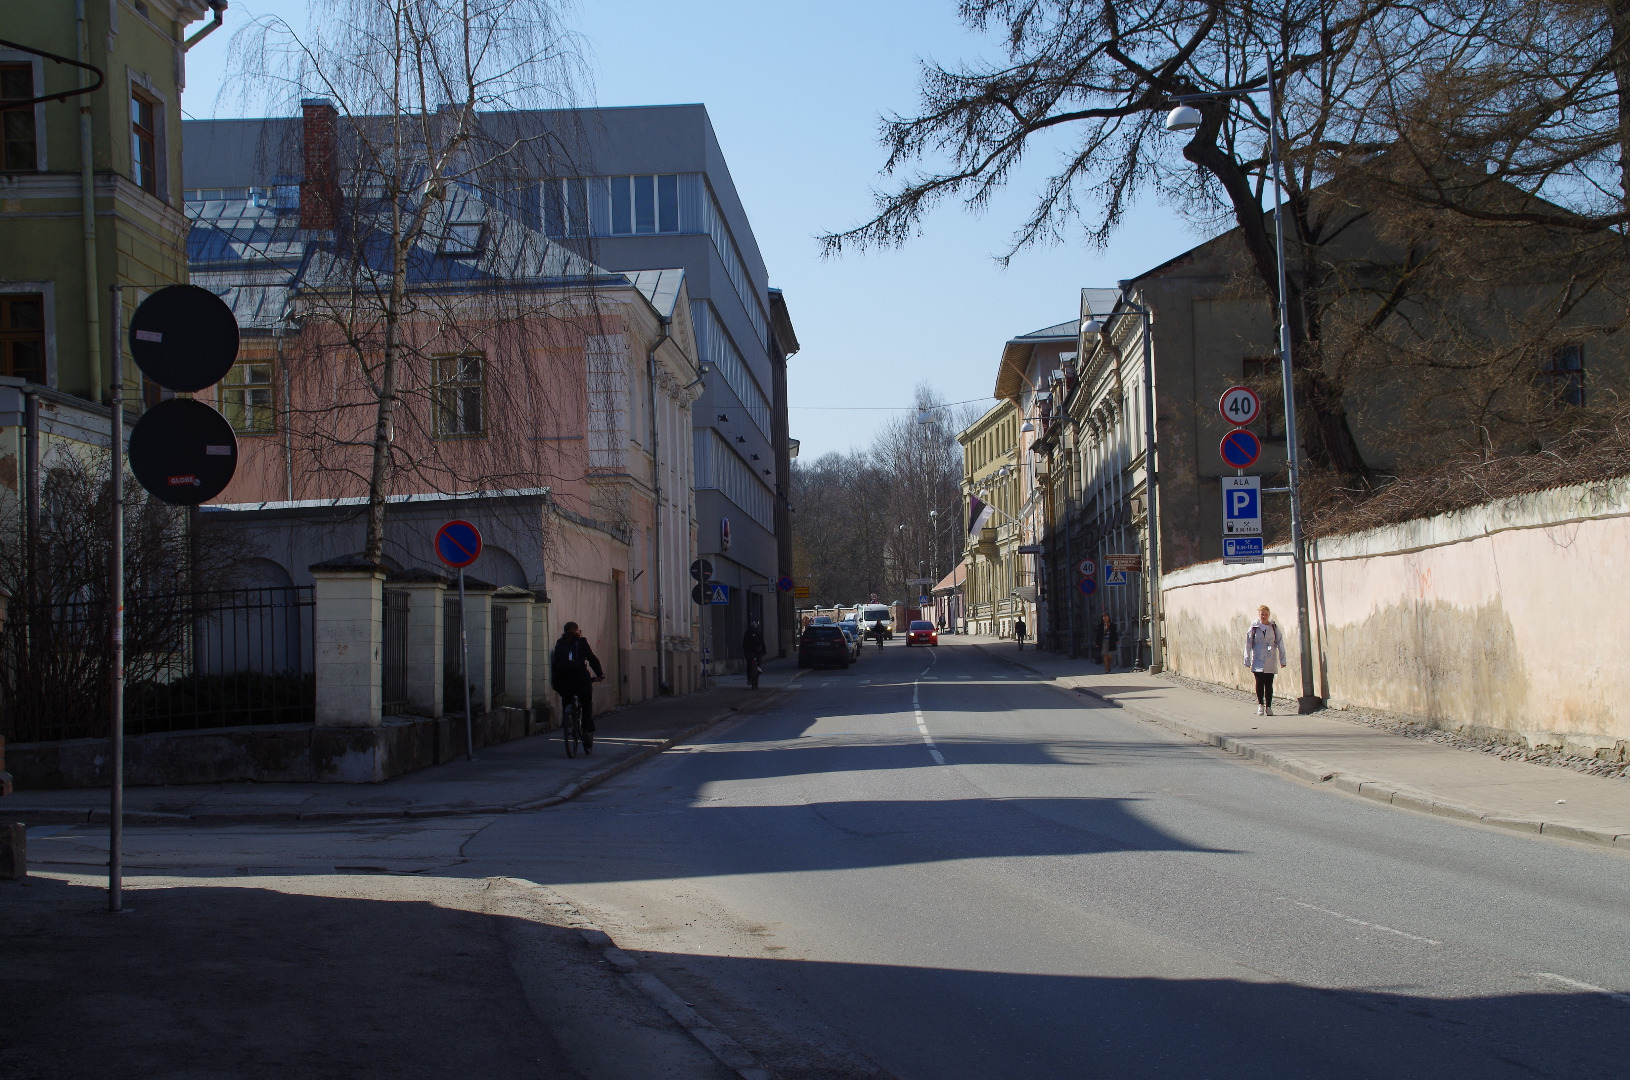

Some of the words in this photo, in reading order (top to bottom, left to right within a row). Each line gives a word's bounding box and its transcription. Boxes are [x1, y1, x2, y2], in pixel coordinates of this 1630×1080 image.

[1229, 397, 1251, 415] 40
[1233, 491, 1250, 516] P
[1083, 563, 1093, 573] 40
